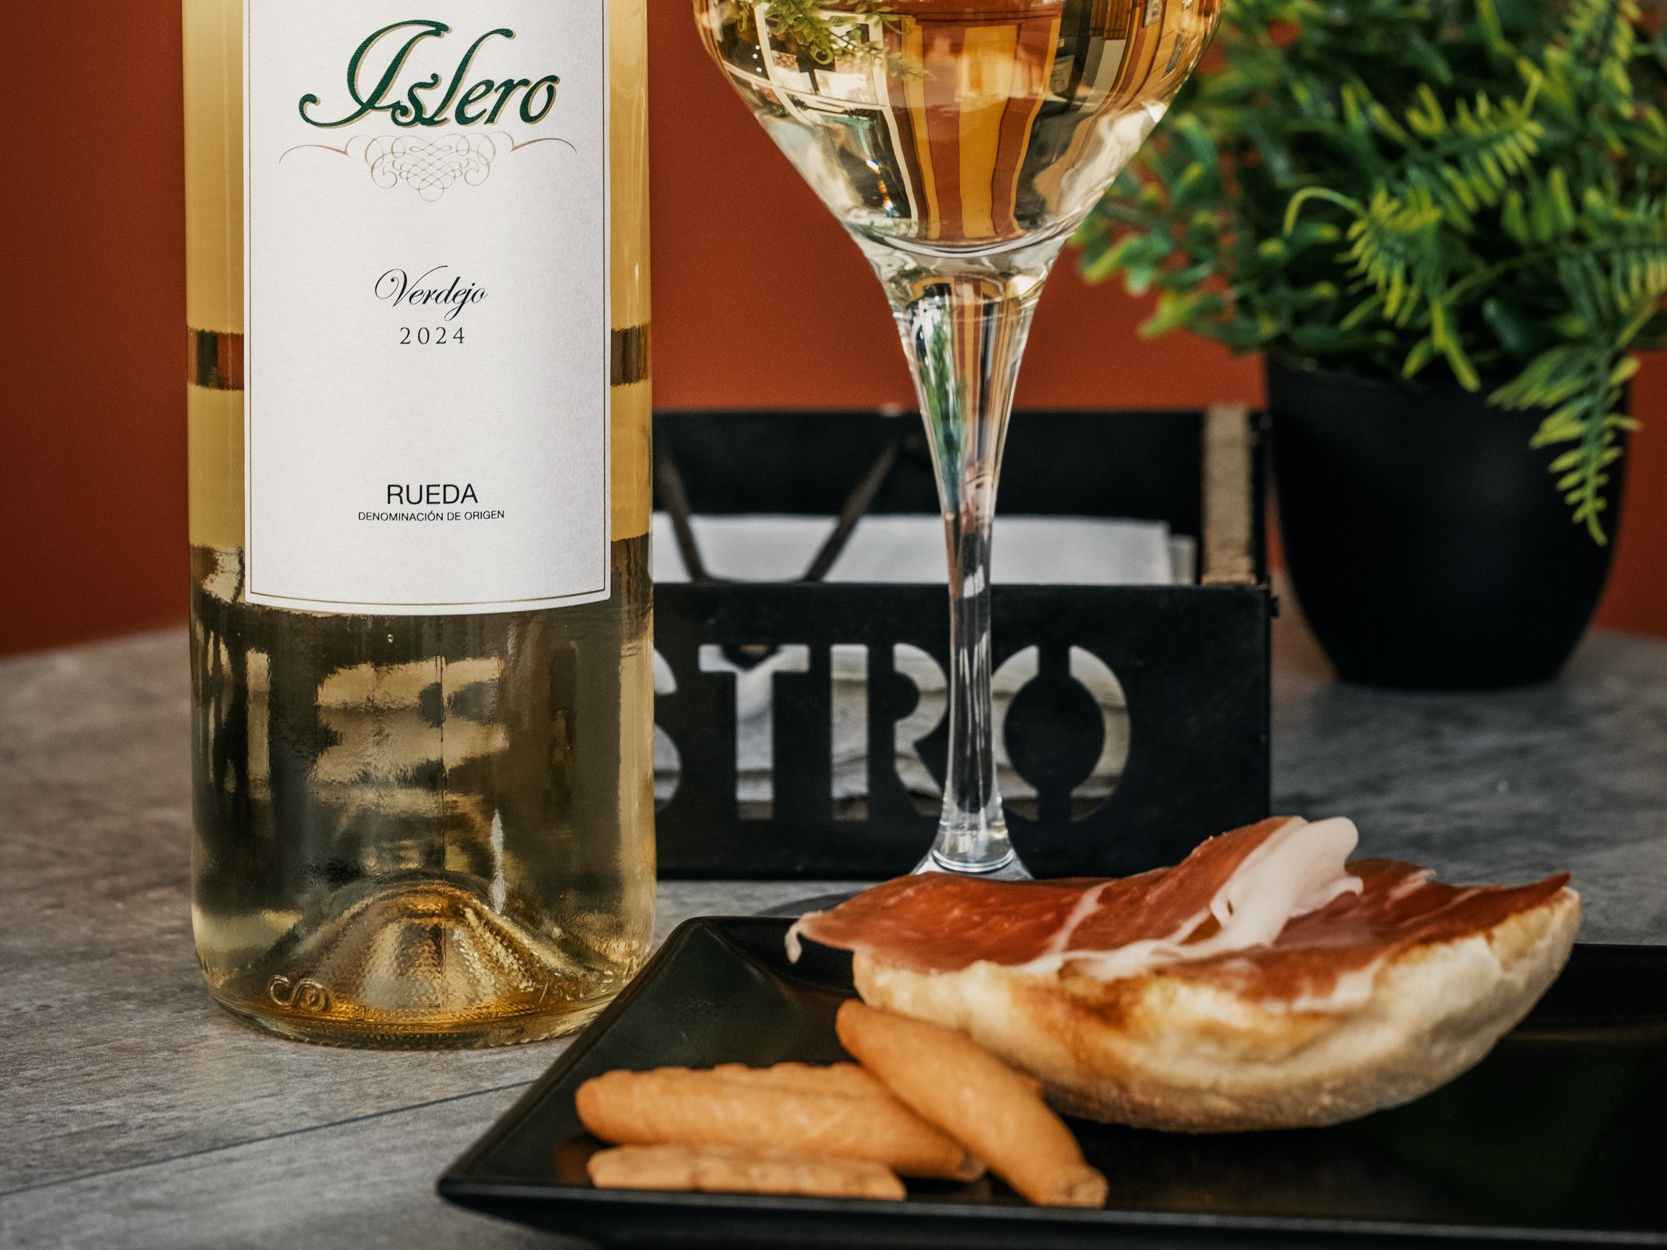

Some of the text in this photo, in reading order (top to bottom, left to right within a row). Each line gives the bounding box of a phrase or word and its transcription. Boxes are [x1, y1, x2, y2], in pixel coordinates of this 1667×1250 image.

[298, 19, 562, 128] Islero
[374, 265, 488, 322] Verdejo
[399, 326, 465, 345] 2024
[387, 483, 479, 505] RUEDA
[358, 509, 505, 521] DENOMINACIÓN DE ORIGEN
[653, 642, 1131, 822] TRO
